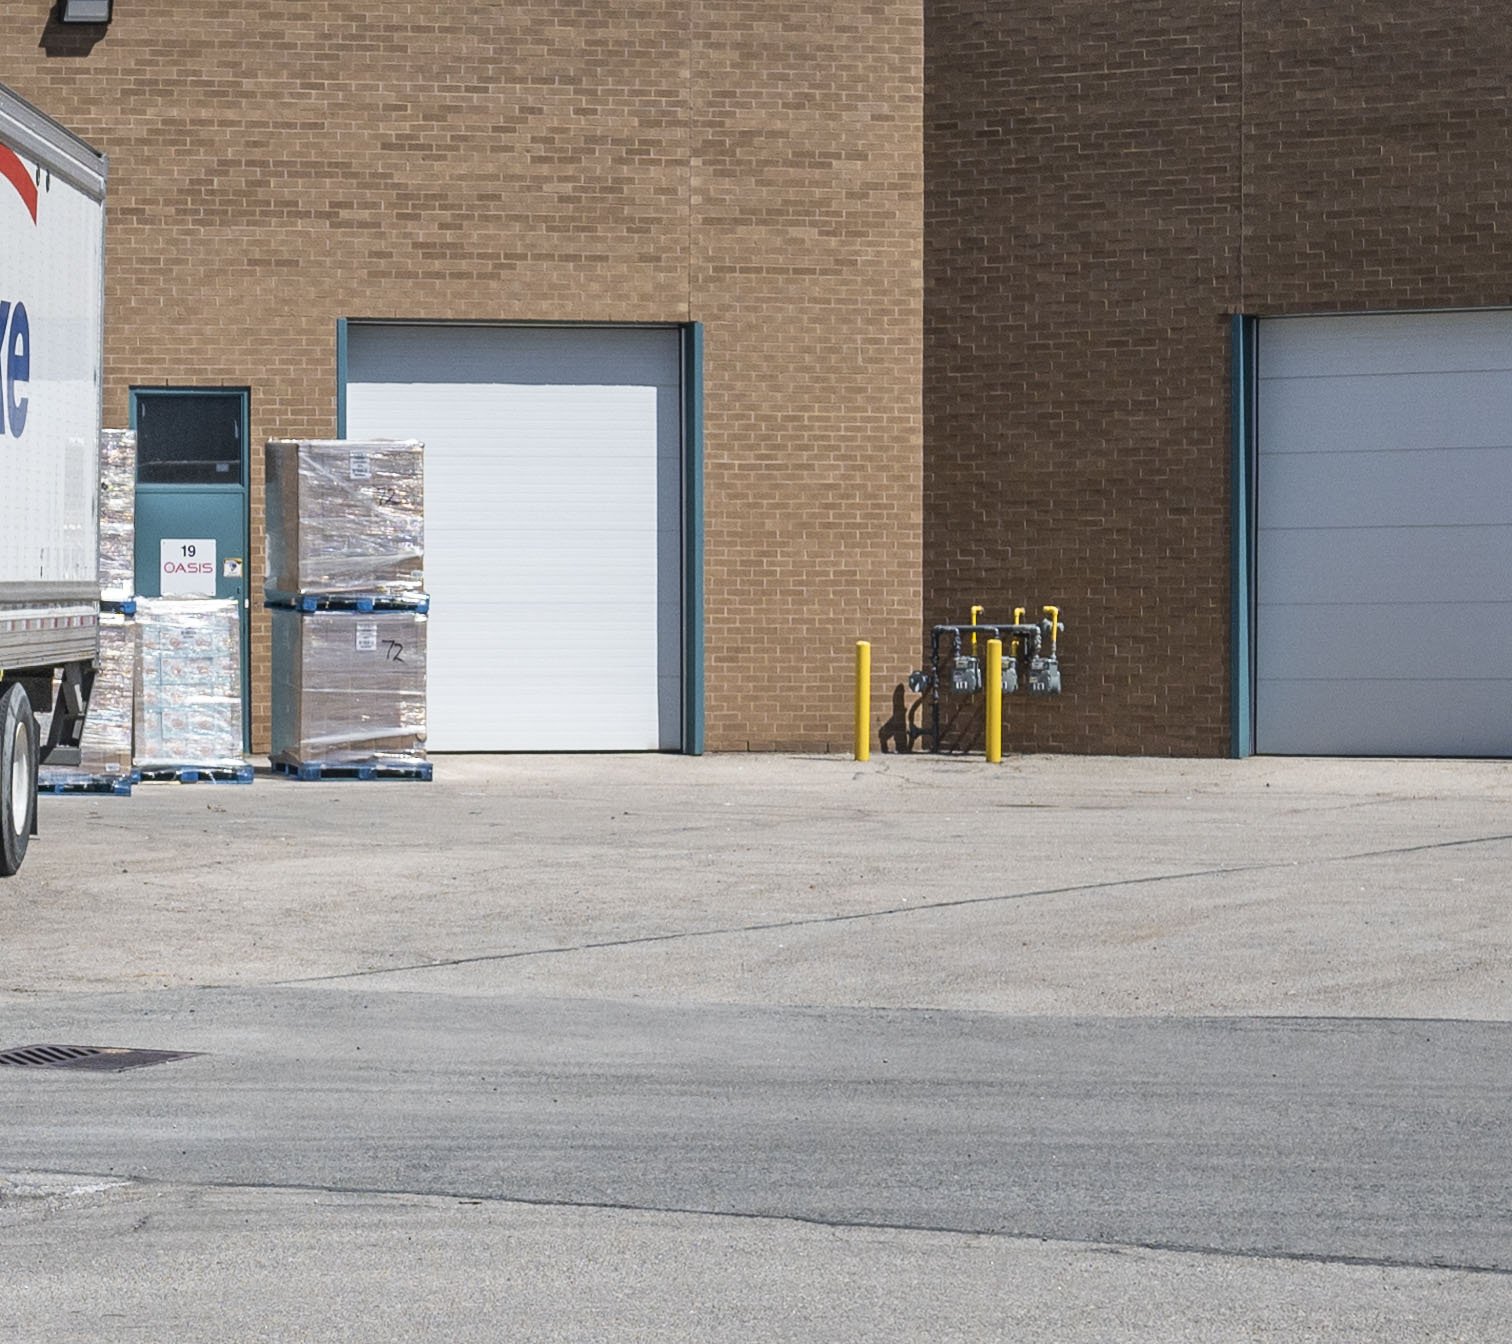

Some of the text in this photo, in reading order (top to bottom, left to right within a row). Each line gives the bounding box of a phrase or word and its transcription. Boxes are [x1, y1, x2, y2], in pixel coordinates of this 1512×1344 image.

[181, 545, 196, 557] 19
[164, 562, 213, 573] OASIS
[382, 640, 407, 663] 72
